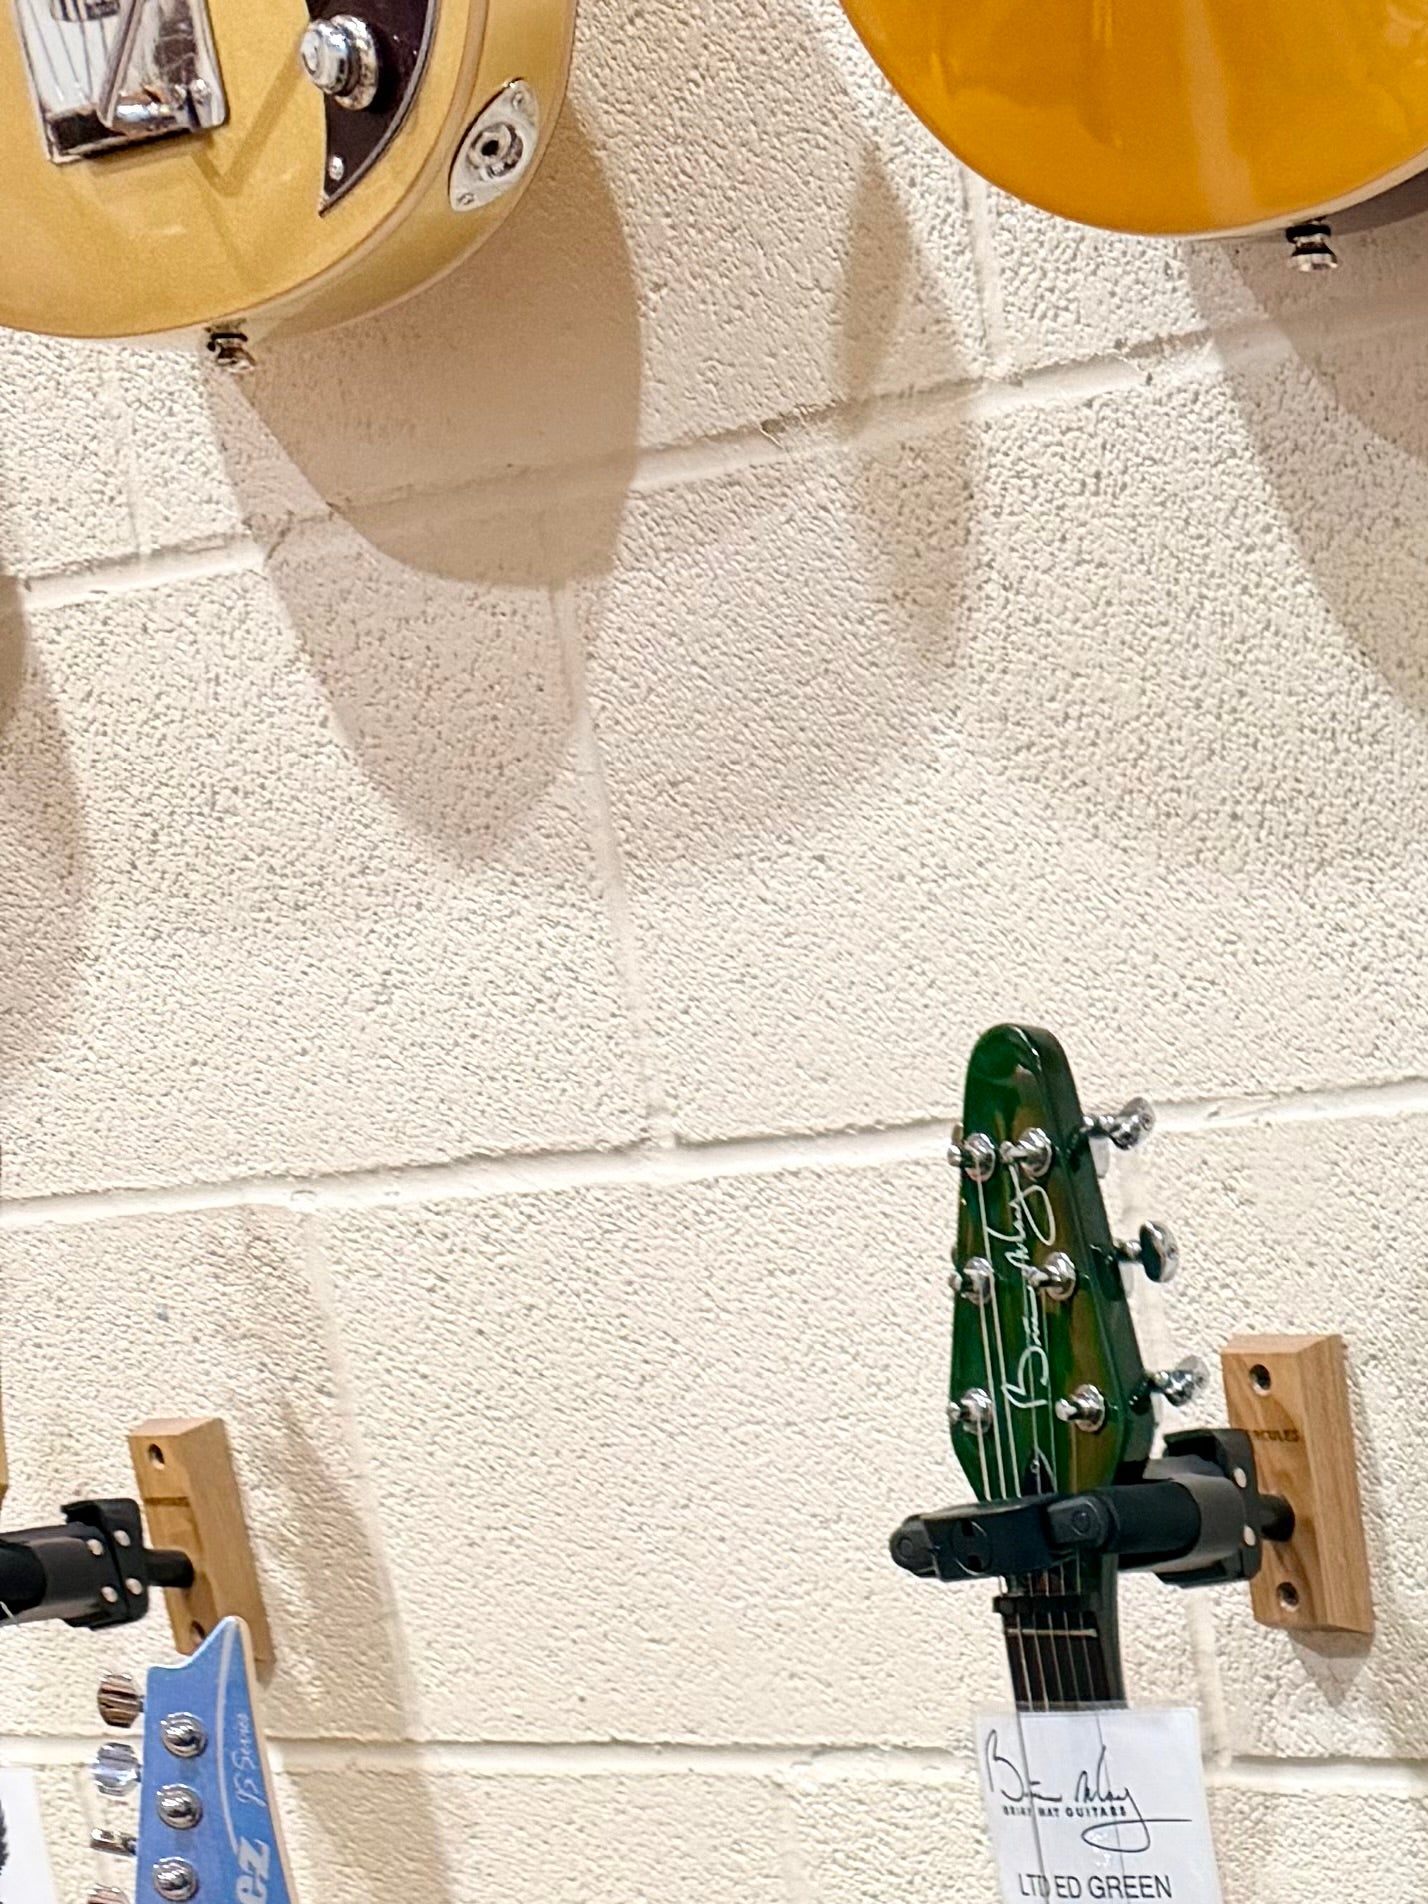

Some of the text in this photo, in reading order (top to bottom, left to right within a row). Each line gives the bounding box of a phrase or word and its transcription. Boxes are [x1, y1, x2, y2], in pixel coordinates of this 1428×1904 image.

[1065, 1805, 1127, 1818] GUITARS
[1018, 1872, 1172, 1899] LTD ED GREEN
